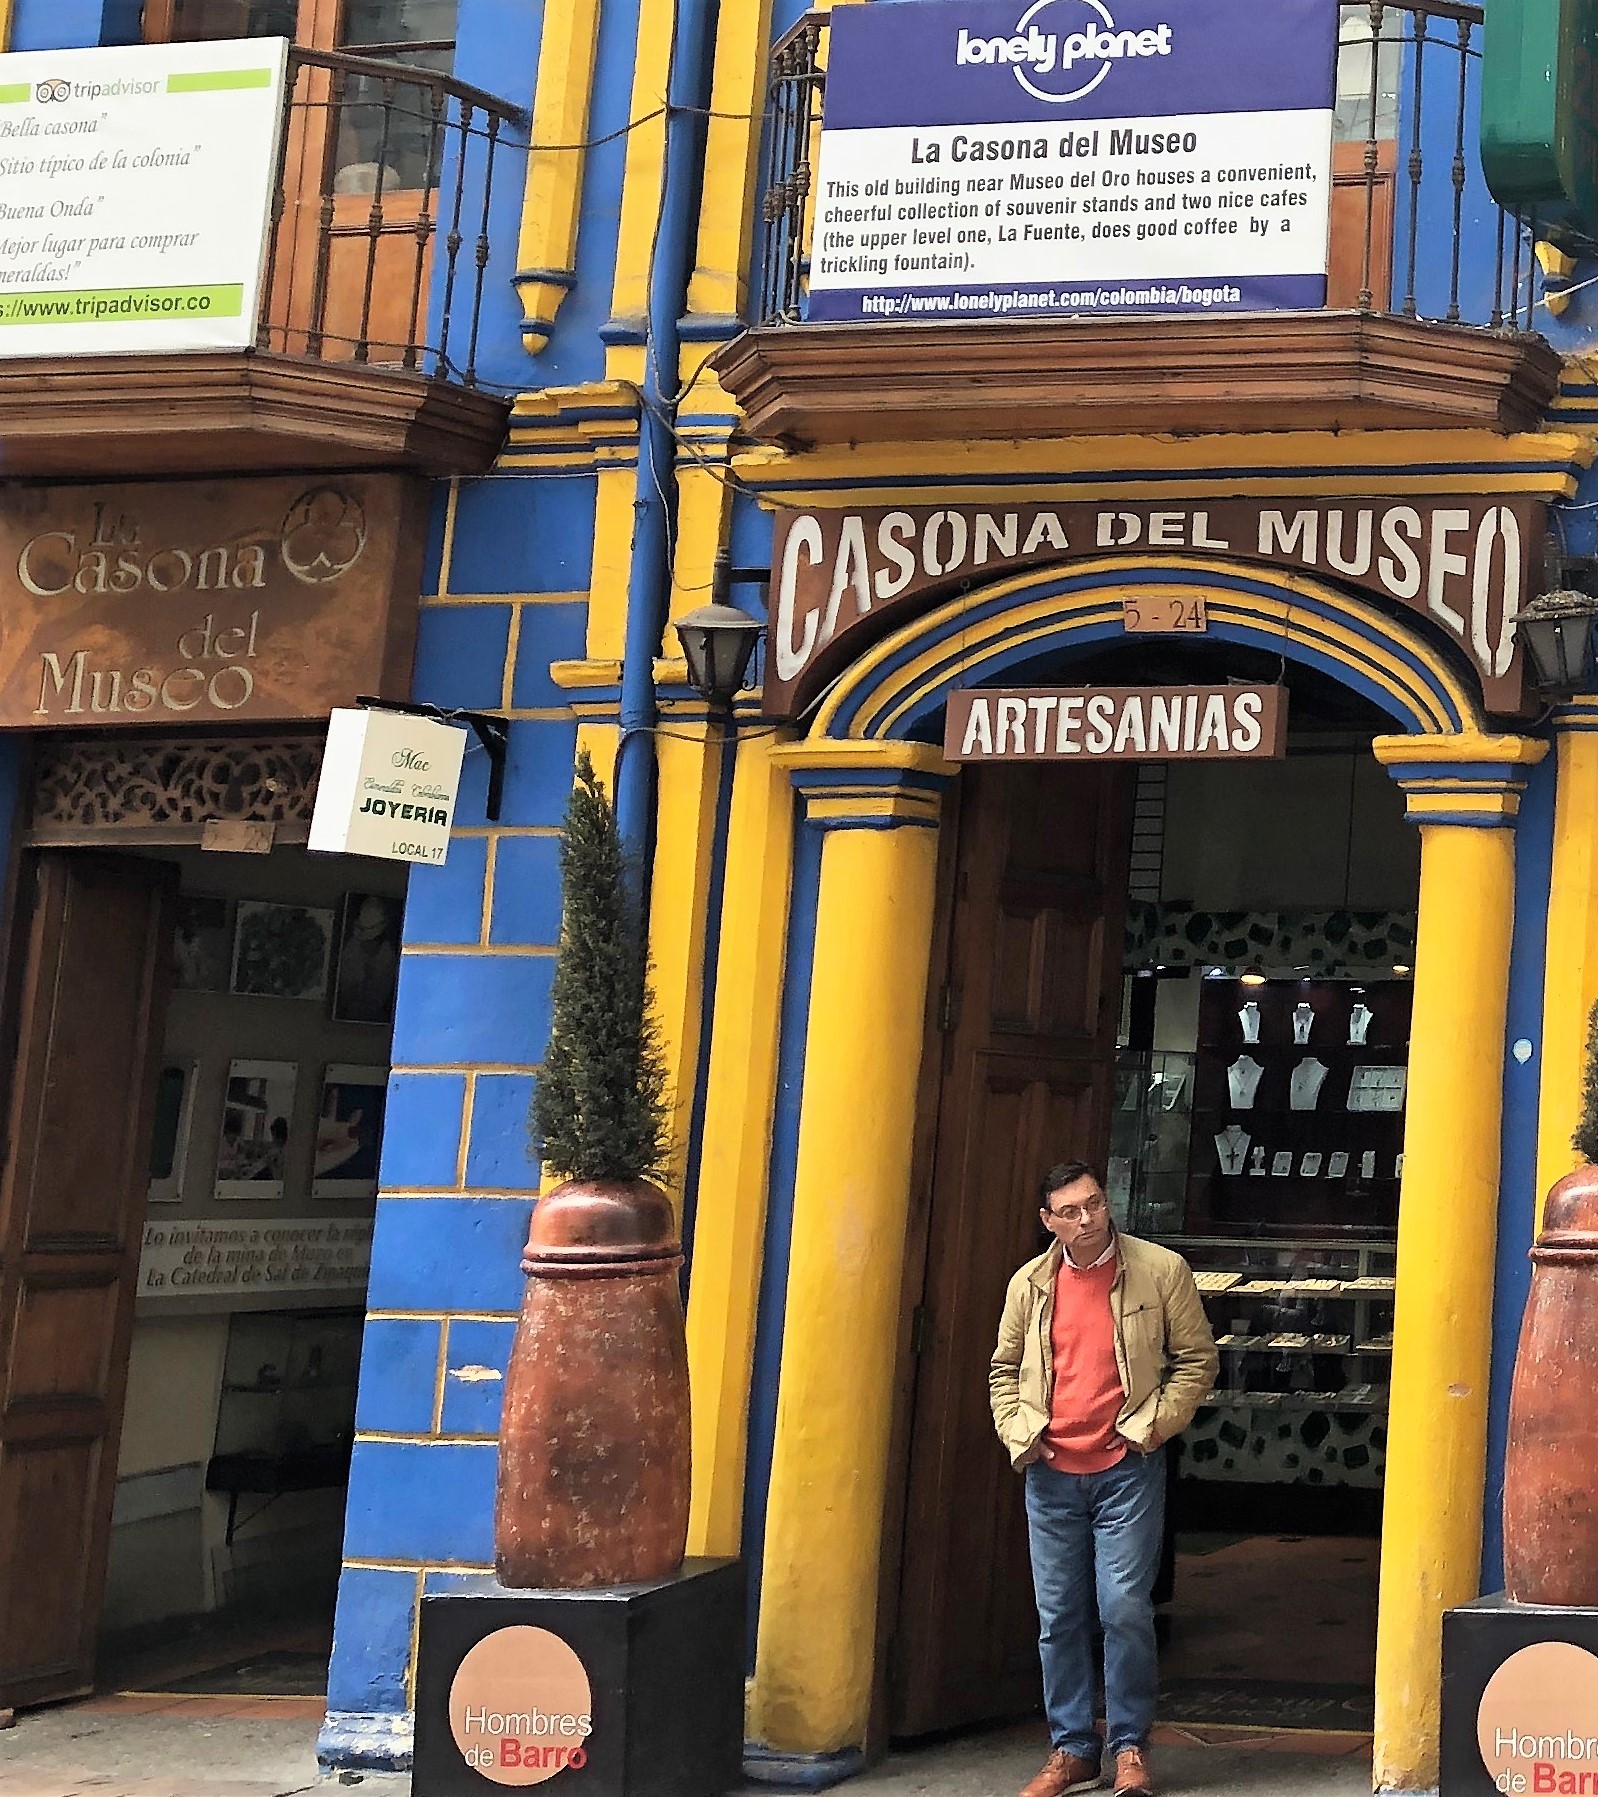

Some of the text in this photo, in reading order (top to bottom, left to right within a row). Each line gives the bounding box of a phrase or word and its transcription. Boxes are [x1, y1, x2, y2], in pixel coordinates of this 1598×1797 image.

[956, 22, 1172, 73] lonely planet
[74, 79, 160, 101] tripadvisor
[911, 129, 1197, 164] La Casona del Museo
[0, 157, 35, 177] Sitio
[39, 154, 85, 179] típico
[88, 150, 108, 171] de
[112, 148, 128, 169] la
[826, 163, 1317, 198] This old building near Museo del Oro houses a convenient,
[0, 202, 45, 220] Buena
[824, 189, 1308, 223] cheerful collection of souvenir stands and two nice cafes
[41, 233, 86, 259] lugar
[86, 236, 126, 257] para
[130, 231, 200, 253] comprar
[823, 216, 1291, 252] (the upper level one, La Fuente, does good coffee by a
[820, 252, 975, 275] trickling fountain).
[862, 284, 1242, 316] http://www.lonelyplanet.com/colombia/bogota
[90, 501, 141, 548] La
[17, 530, 267, 598] Casona
[777, 506, 1521, 684] CASONA DEL MUSEO
[177, 609, 260, 660] del
[33, 649, 255, 716] Museo
[961, 692, 1264, 756] ARTESANIAS
[391, 841, 444, 860] LOCAL 17
[145, 1227, 164, 1246] Lo
[183, 1245, 202, 1265] de
[207, 1246, 221, 1264] la
[146, 1268, 164, 1287] La
[171, 1265, 238, 1286] Catedral
[242, 1265, 261, 1284] de
[464, 1705, 594, 1737] Hombres
[464, 1738, 589, 1770] de Barro
[1495, 1768, 1527, 1795] de
